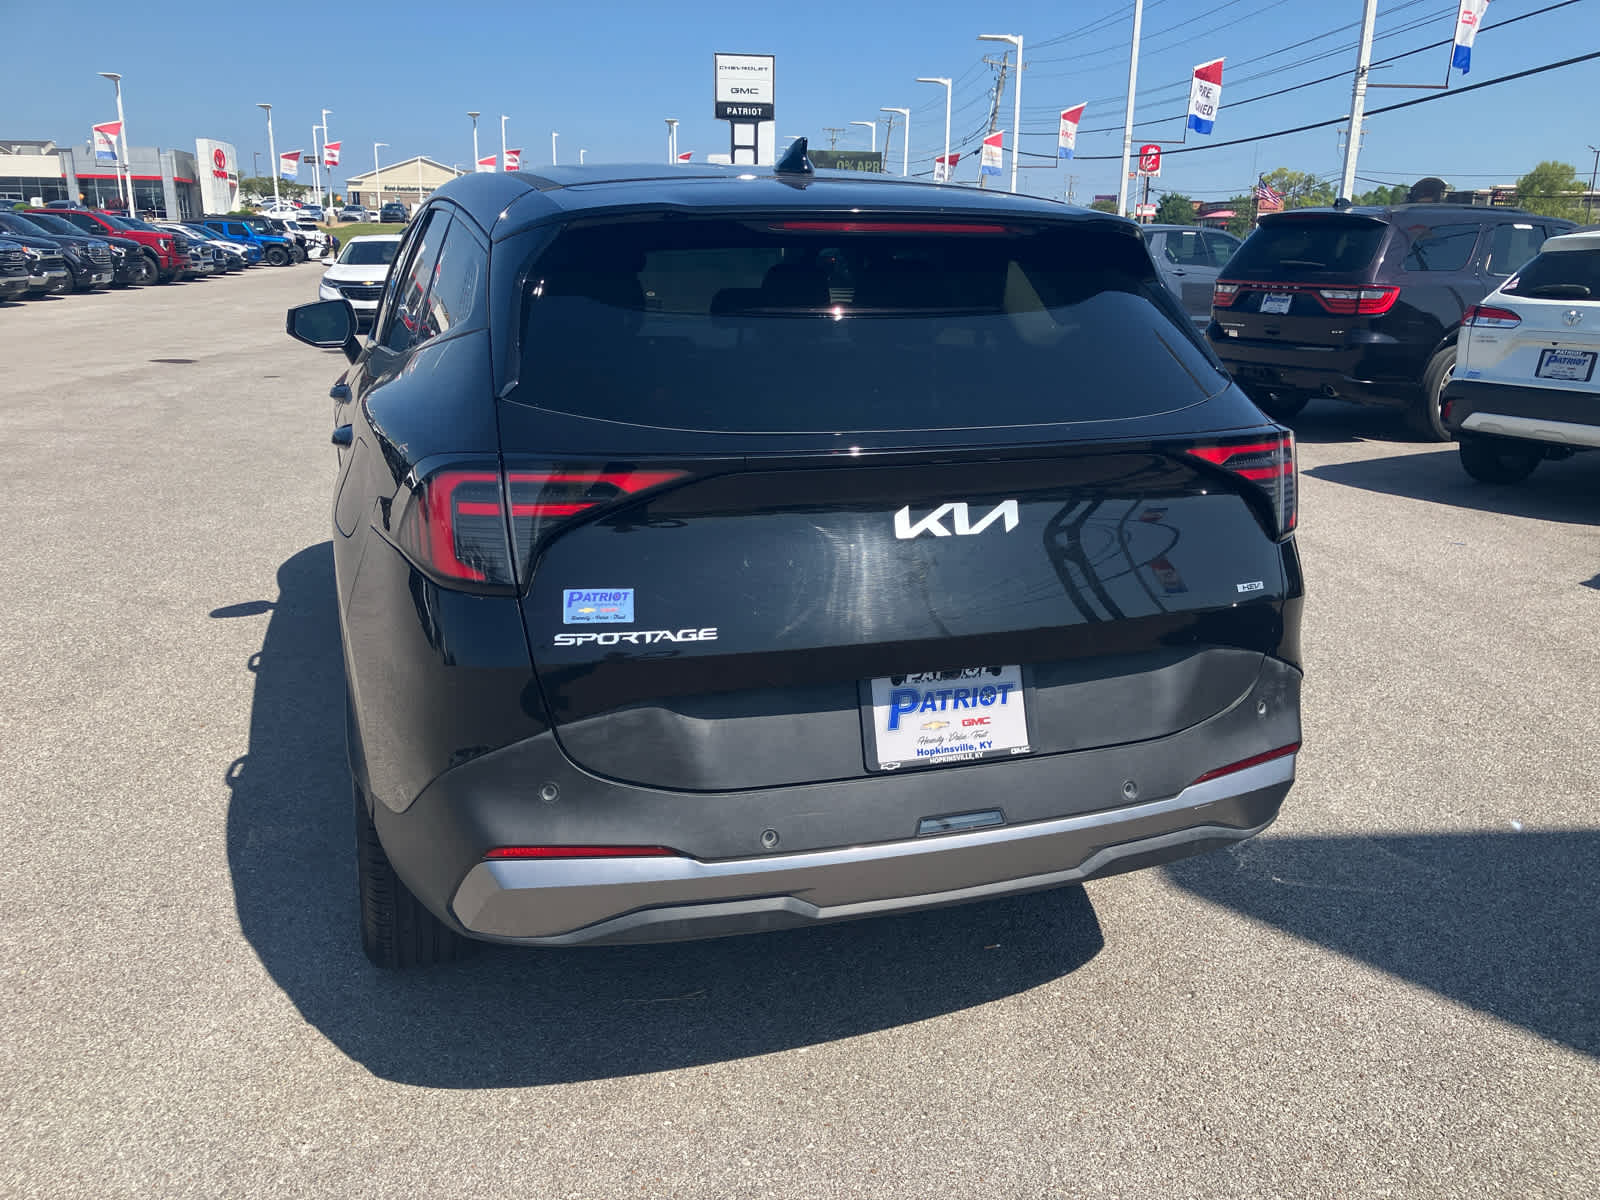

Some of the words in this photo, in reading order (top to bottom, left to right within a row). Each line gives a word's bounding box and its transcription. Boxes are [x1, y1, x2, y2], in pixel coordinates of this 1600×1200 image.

[730, 87, 760, 95] GMC
[726, 106, 763, 116] PATRIOT
[857, 160, 880, 173] APR
[1544, 354, 1589, 367] PATRIOT
[894, 499, 1019, 539] KIA
[567, 591, 630, 608] PATRIOT
[554, 627, 718, 646] SPORTAGE
[888, 681, 1016, 731] PATRIOT
[962, 716, 992, 727] GMC
[916, 743, 978, 757] Hopkinsville,
[979, 740, 993, 750] KY
[974, 751, 984, 759] KY
